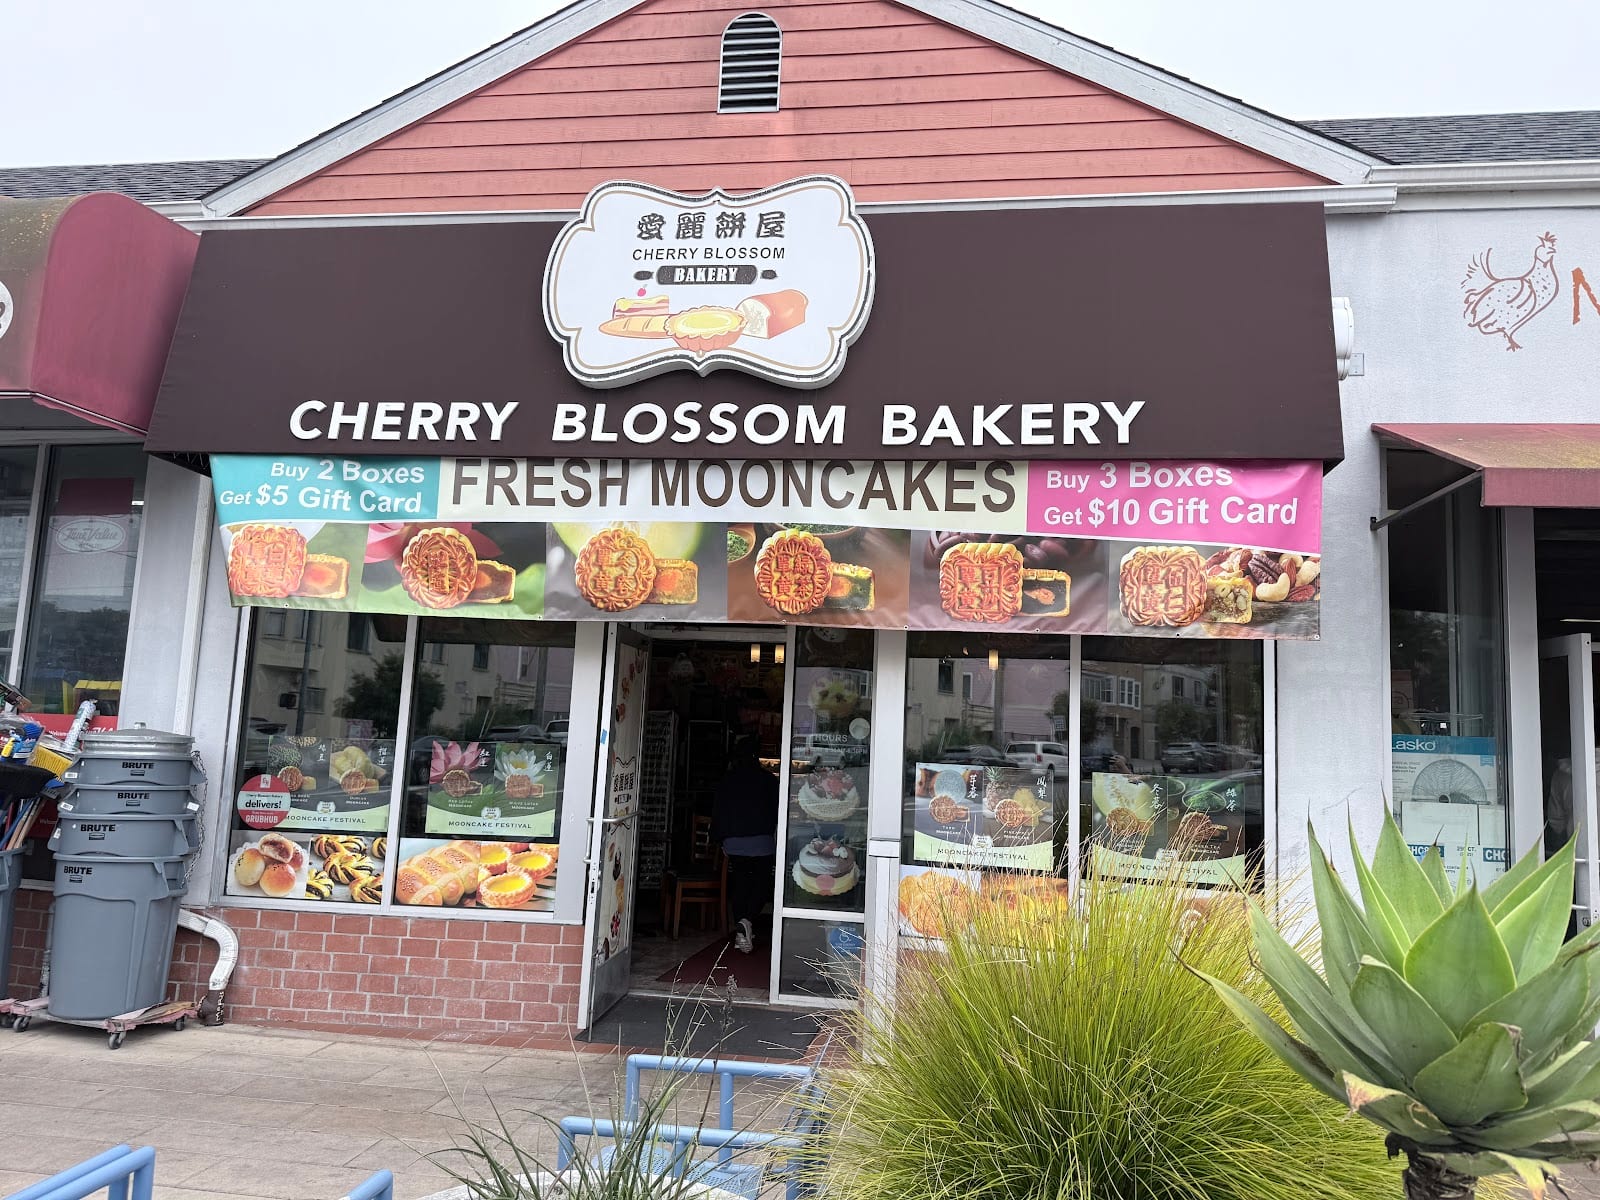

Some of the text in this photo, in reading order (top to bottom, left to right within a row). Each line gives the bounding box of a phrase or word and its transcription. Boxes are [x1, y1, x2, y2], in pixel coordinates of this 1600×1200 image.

[636, 211, 785, 241] 愛麗餅屋
[632, 246, 785, 261] CHERRY BLOSSOM
[673, 266, 738, 283] BAKERY
[289, 400, 1146, 447] CHERRY BLOSSOM BAKERY
[271, 459, 425, 484] Buy 2 Boxes
[1046, 462, 1233, 492] Buy 3 Boxes
[452, 458, 1016, 513] FRESH MOONCAKES
[219, 483, 422, 514] Get $5 Gift Card
[1044, 496, 1298, 527] Get $10 Gift Card
[87, 527, 119, 543] Value
[814, 733, 848, 743] HOURS
[121, 761, 155, 770] BRUTE
[117, 792, 150, 800] BRUTE
[245, 799, 282, 809] delivers!
[245, 815, 279, 824] GRUBHUB
[448, 820, 493, 828] MOONCAKE
[80, 824, 116, 832] BRUTE
[937, 848, 984, 857] MOONCAKE
[63, 866, 93, 875] BRUTE
